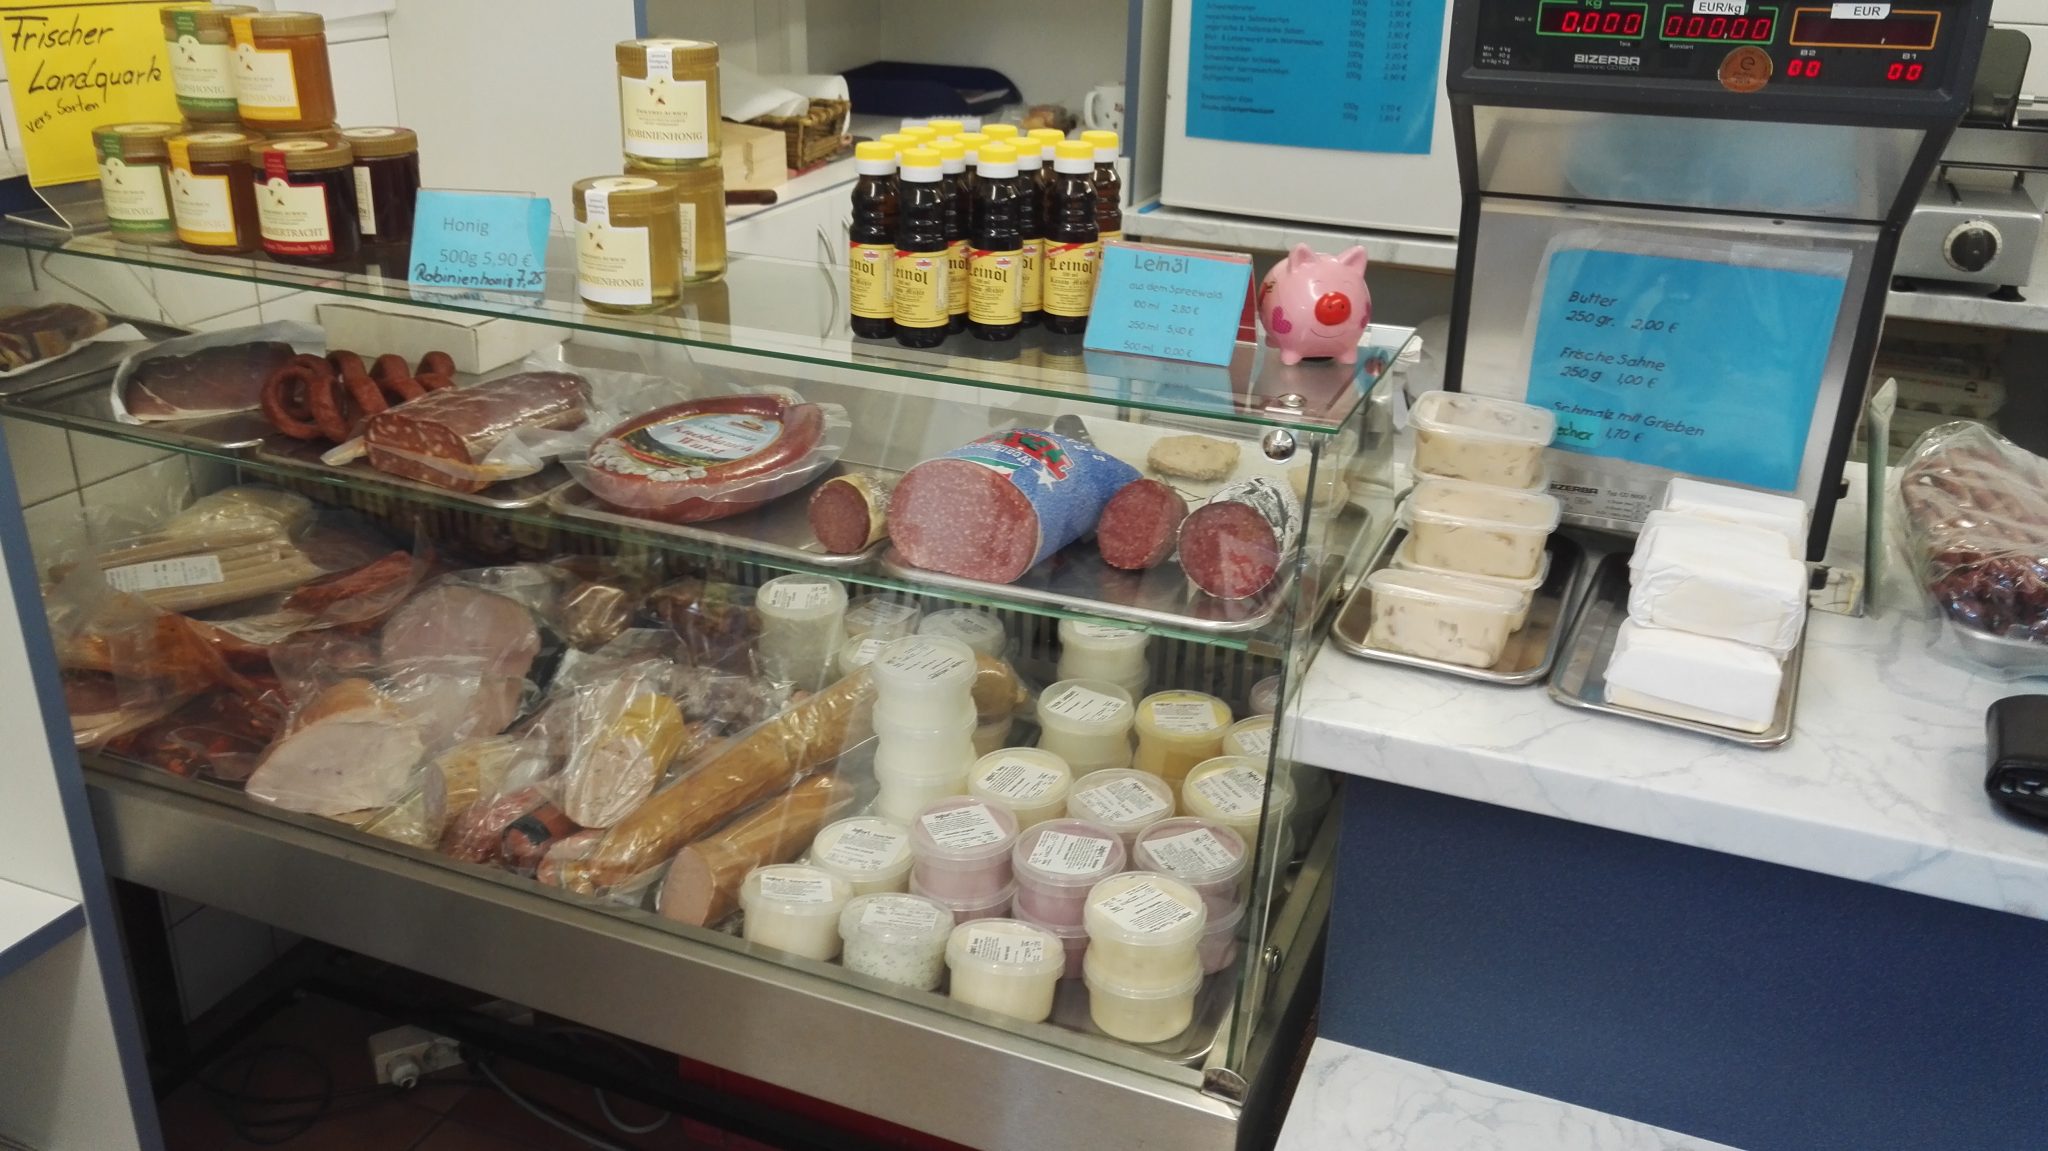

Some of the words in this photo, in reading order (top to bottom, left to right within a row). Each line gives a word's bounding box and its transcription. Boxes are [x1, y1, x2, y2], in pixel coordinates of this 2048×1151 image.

[1698, 0, 1741, 14] EUR/kg
[1853, 6, 1881, 16] EUR
[4, 13, 114, 52] Frischer
[1561, 12, 1642, 34] 0,000
[1665, 16, 1772, 39] 000,00
[1574, 54, 1640, 65] BIZERBA
[1787, 59, 1822, 78] 00
[28, 54, 161, 104] Landquark
[1887, 63, 1923, 81] 00
[26, 111, 52, 133] vers
[57, 95, 99, 115] Sorten
[443, 218, 489, 237] Honig
[440, 249, 478, 268] 500g
[482, 252, 517, 268] 5,90
[521, 254, 533, 267] €
[1049, 257, 1094, 274] Leinöl
[1134, 254, 1190, 274] Leinöl
[1146, 282, 1167, 293] dem
[1169, 284, 1223, 299] Spreewald
[1568, 291, 1618, 307] Butter
[1134, 300, 1146, 309] 100
[1148, 302, 1160, 310] ml
[1193, 305, 1200, 316] €
[1128, 320, 1146, 330] 250
[1147, 323, 1159, 331] ml
[1187, 327, 1195, 337] €
[1565, 310, 1594, 323] 250
[1595, 315, 1615, 327] gr.
[1631, 318, 1665, 331] 2,00
[1668, 322, 1679, 333] €
[1123, 340, 1141, 350] 500
[1186, 347, 1193, 358] €
[1560, 347, 1614, 365] Frische
[1617, 354, 1665, 371] Sahne
[1560, 366, 1589, 378] 250
[1590, 371, 1602, 383] g
[1617, 372, 1644, 386] 1,00
[1647, 377, 1658, 389] €
[1554, 401, 1614, 420] Schmalz
[1618, 412, 1642, 423] mit
[1644, 415, 1705, 437] Grieben
[1605, 427, 1631, 440] 1,70
[1633, 432, 1645, 443] €
